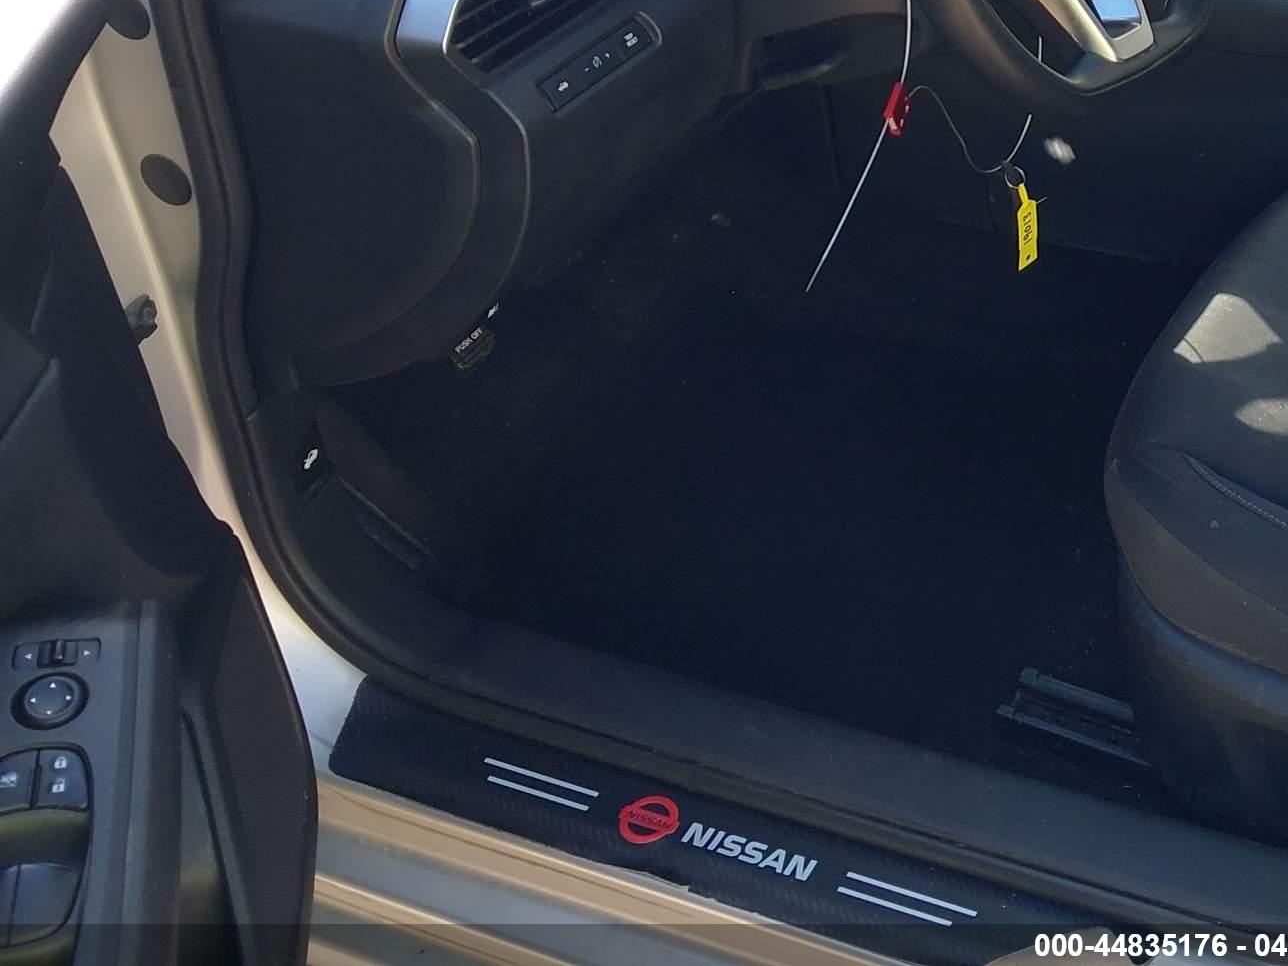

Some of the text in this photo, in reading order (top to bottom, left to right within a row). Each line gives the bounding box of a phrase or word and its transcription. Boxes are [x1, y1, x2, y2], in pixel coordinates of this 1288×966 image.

[454, 327, 483, 354] PUSH OFF
[628, 809, 673, 829] NISSAN
[681, 822, 819, 881] NISSAN
